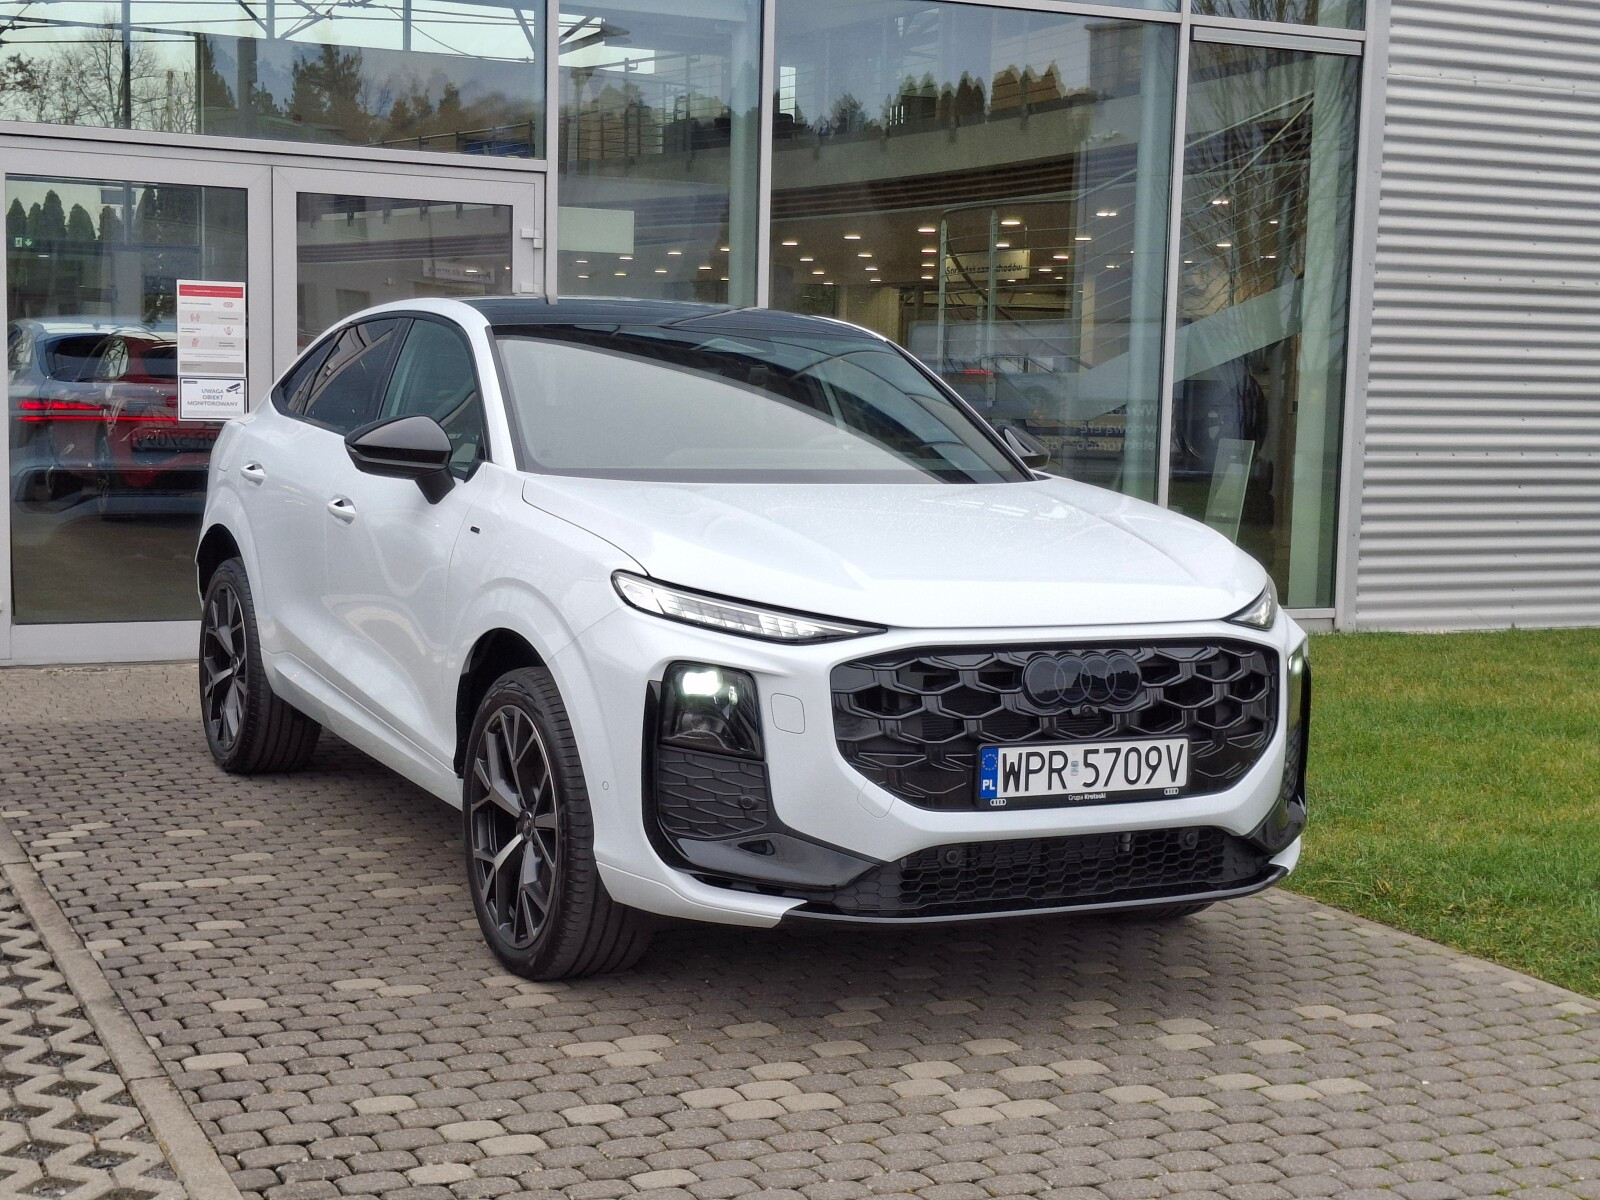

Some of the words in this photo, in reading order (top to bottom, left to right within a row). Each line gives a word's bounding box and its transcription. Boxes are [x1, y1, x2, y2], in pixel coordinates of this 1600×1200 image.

[1002, 750, 1069, 793] WPR
[1082, 744, 1184, 788] 5709V
[982, 779, 996, 791] PL
[1068, 794, 1084, 802] Grupa
[1084, 792, 1107, 800] Krotoski
